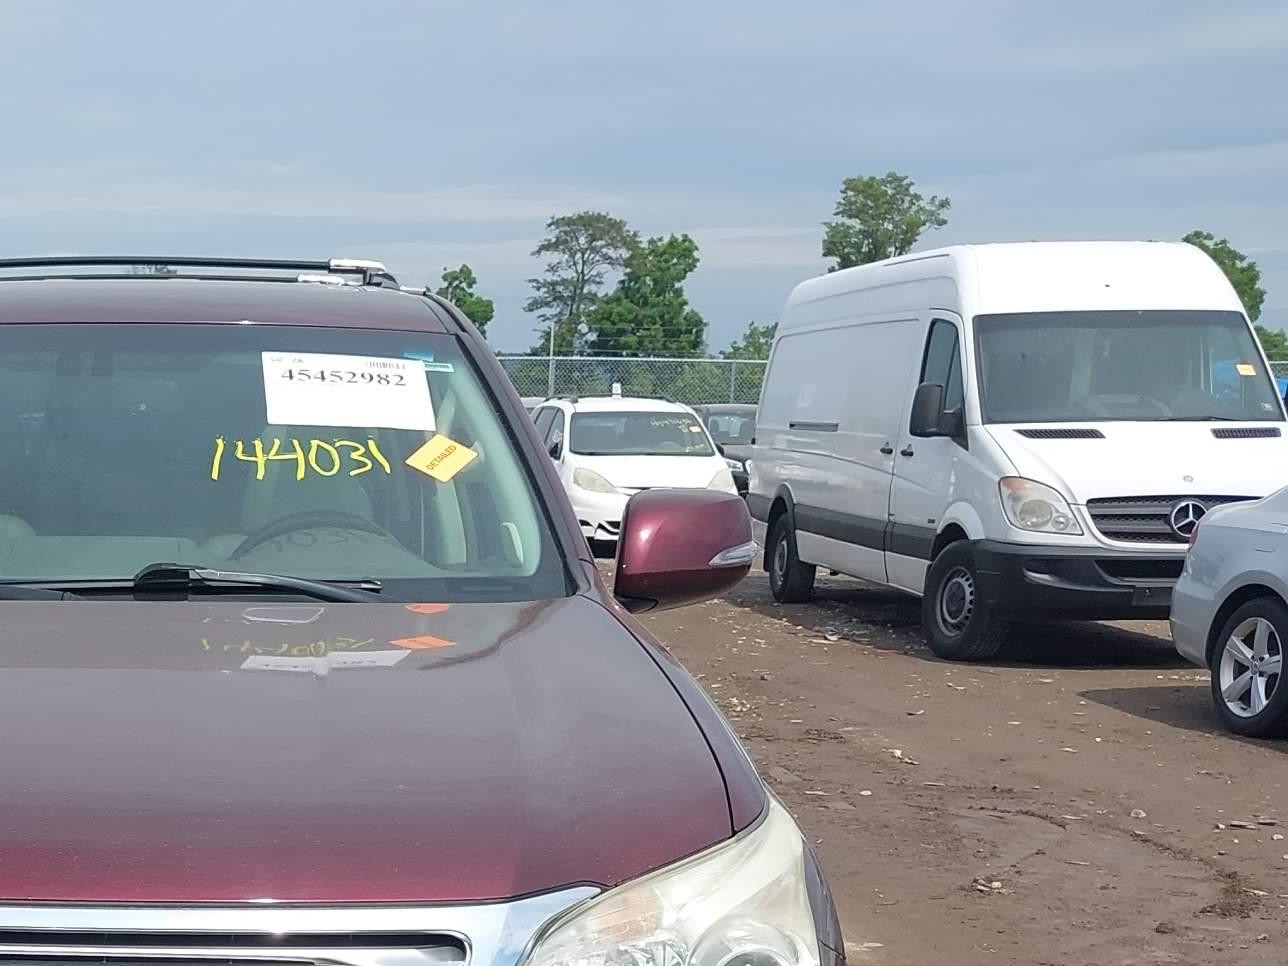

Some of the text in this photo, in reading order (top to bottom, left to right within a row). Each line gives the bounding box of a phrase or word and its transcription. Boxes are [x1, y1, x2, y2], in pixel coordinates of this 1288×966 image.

[281, 368, 407, 387] 45452982
[211, 435, 392, 481] 144031
[425, 444, 457, 471] DETAILED
